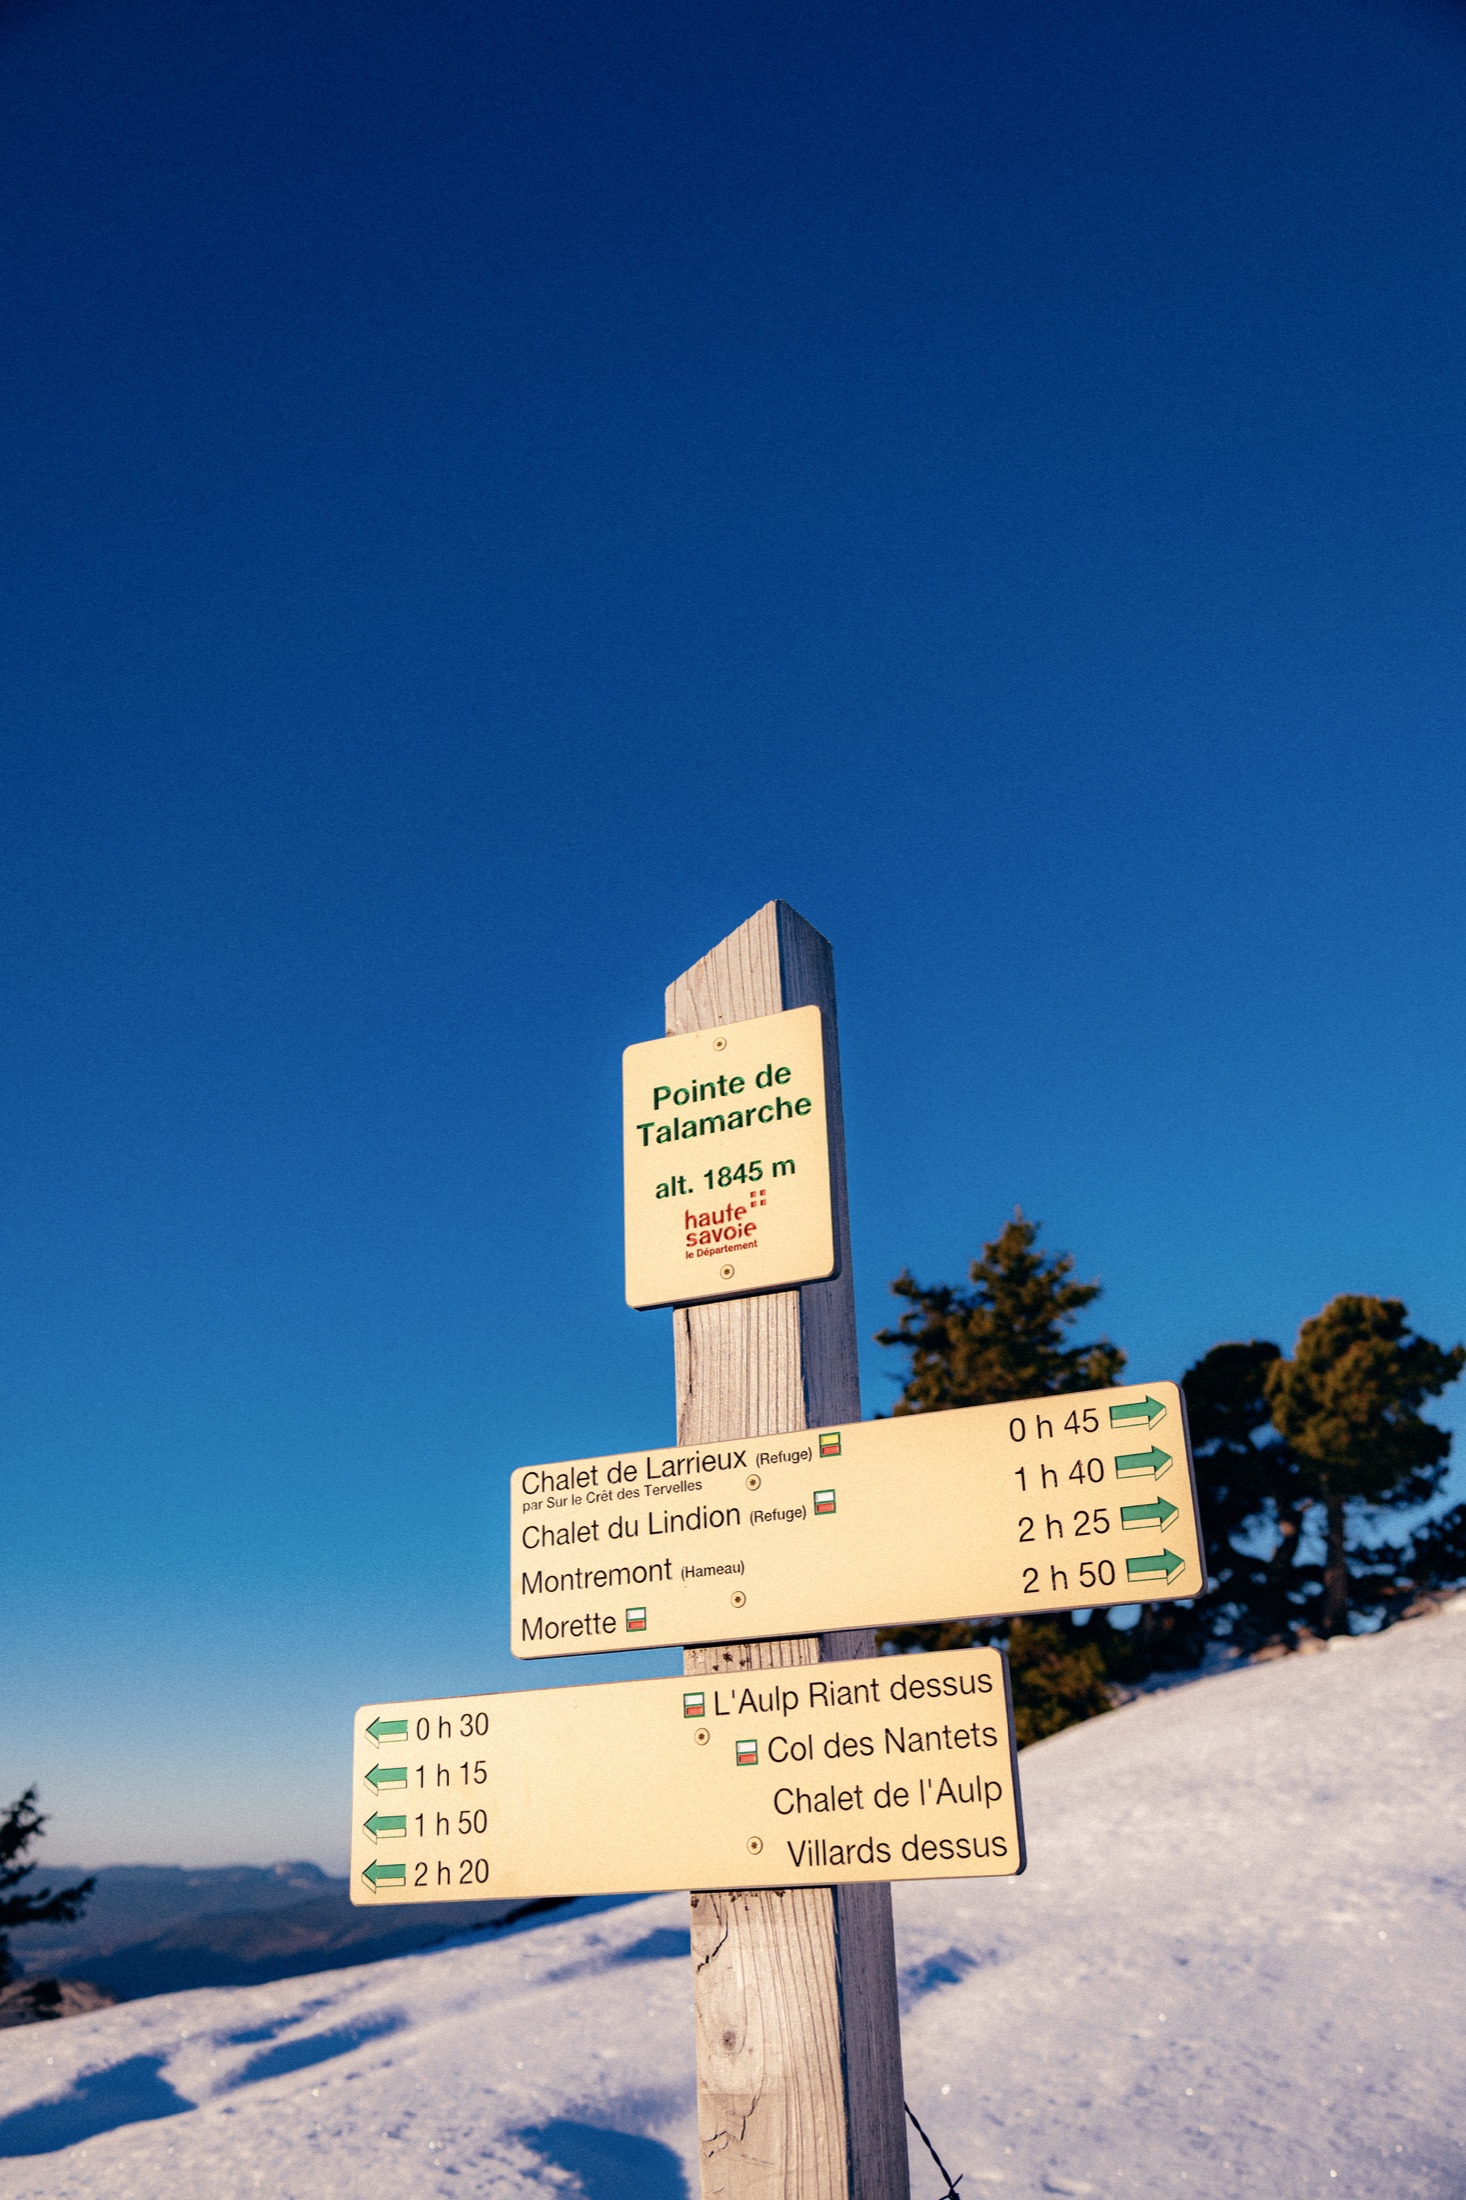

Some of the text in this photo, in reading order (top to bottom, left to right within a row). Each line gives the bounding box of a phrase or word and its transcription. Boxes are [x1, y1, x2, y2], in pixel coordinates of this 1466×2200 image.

[653, 1063, 791, 1110] Pointe de
[636, 1096, 812, 1147] Talamarche
[655, 1159, 796, 1199] alt. 1845 m
[685, 1202, 747, 1230] haute
[685, 1239, 758, 1259] le Département
[686, 1221, 757, 1247] savoie
[1009, 1408, 1099, 1442] 0 h 45
[522, 1447, 813, 1494] Chalet de Larrieux (Refuge)
[1015, 1458, 1104, 1491] 1 h 40
[522, 1480, 702, 1514] par Sur le Crêt des Tervelles
[522, 1505, 807, 1549] Chalet du Lindion (Refuge)
[1018, 1509, 1110, 1542] 2 h 25
[521, 1558, 745, 1595] Montremont (Hameau)
[1023, 1560, 1115, 1593] 2 h 50
[521, 1612, 617, 1641] Morette
[714, 1673, 993, 1717] L'Aulp Riant dessus
[417, 1712, 489, 1740] 0 h 30
[768, 1723, 998, 1763] Col des Nantets
[416, 1761, 487, 1788] 1 h 15
[774, 1775, 1003, 1815] Chalet de l'Aulp
[415, 1809, 487, 1836] 1 h 50
[787, 1834, 1007, 1867] Villards dessus
[415, 1859, 489, 1886] 2 h 20
